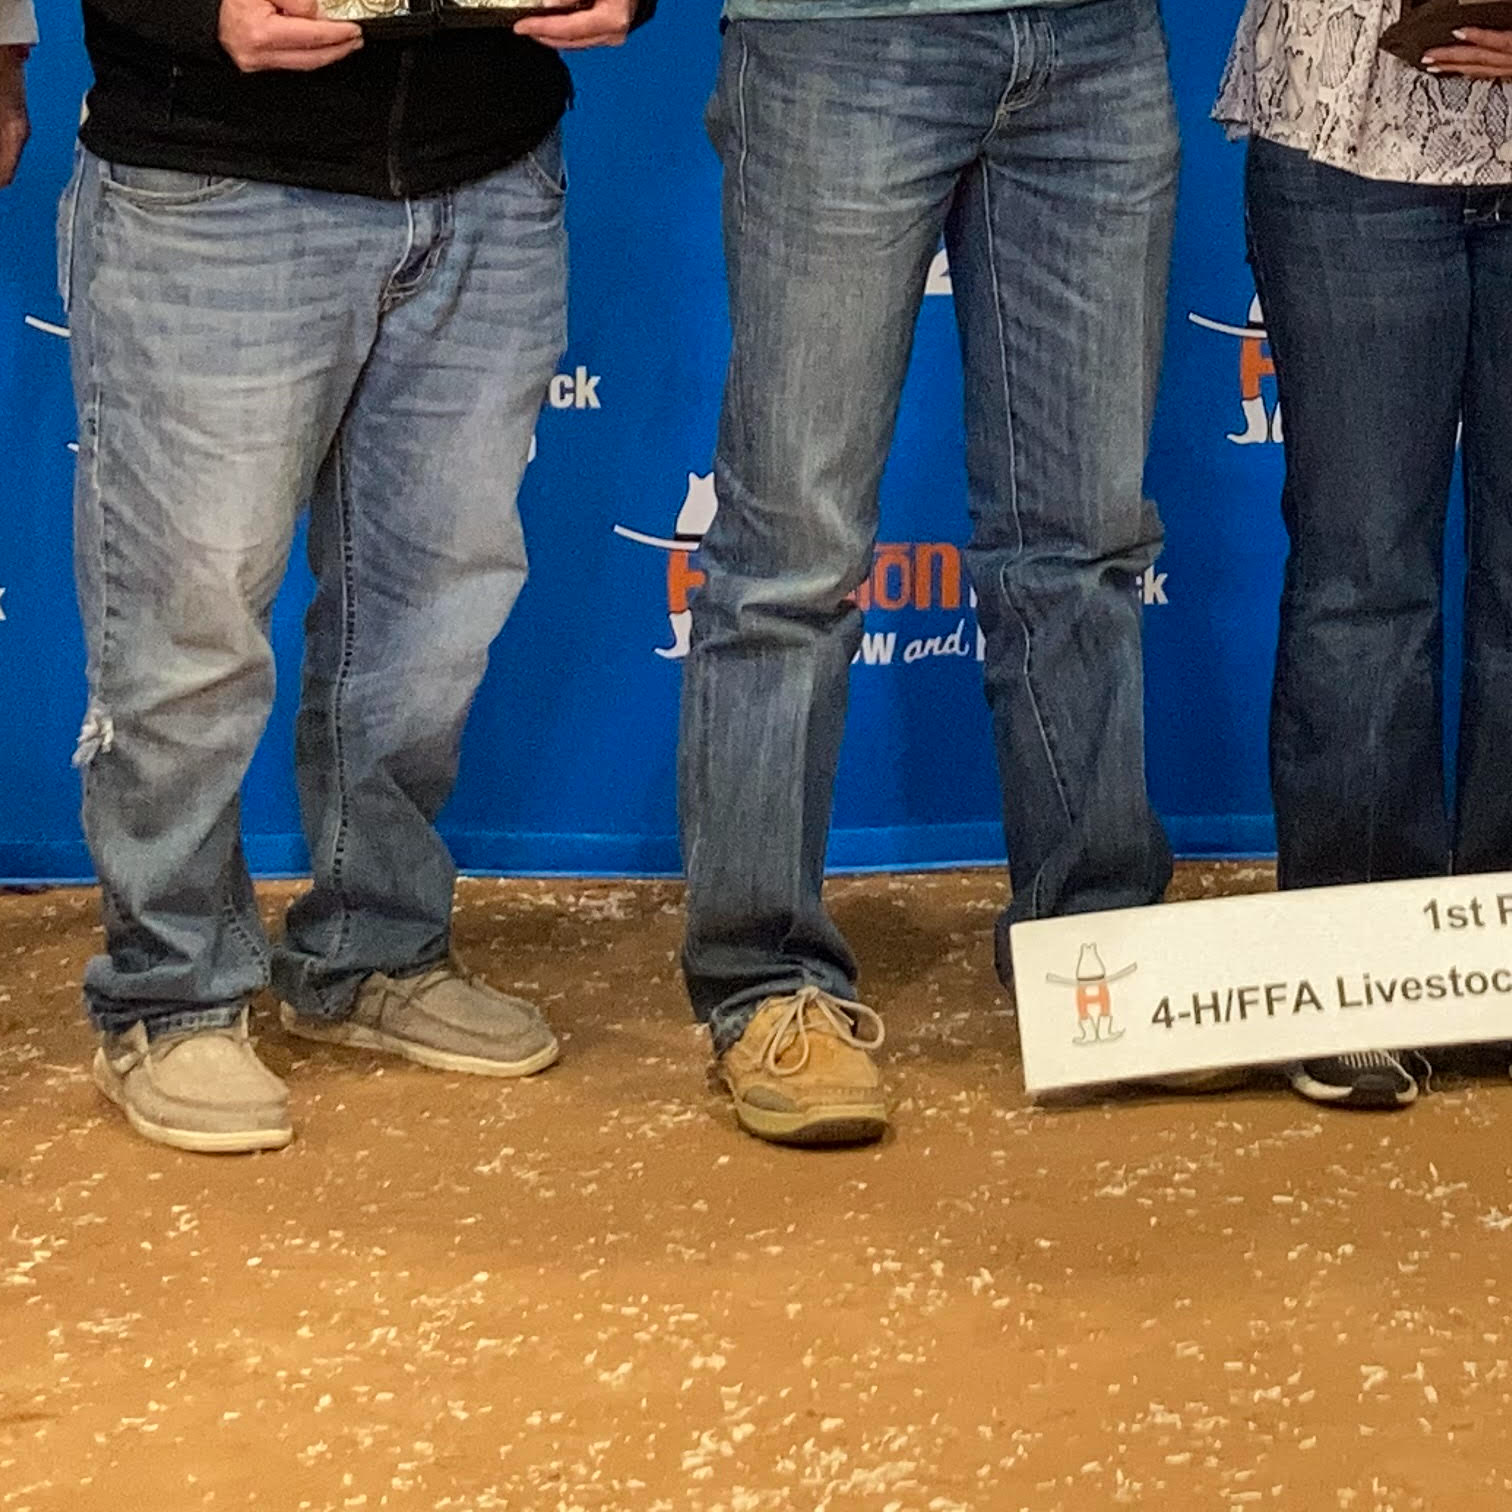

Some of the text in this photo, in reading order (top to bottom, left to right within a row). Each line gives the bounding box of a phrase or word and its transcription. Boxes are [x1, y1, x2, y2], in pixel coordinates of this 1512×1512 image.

[903, 618, 970, 665] and
[1422, 896, 1485, 931] 1st
[1150, 981, 1323, 1029] 4-H/FFA
